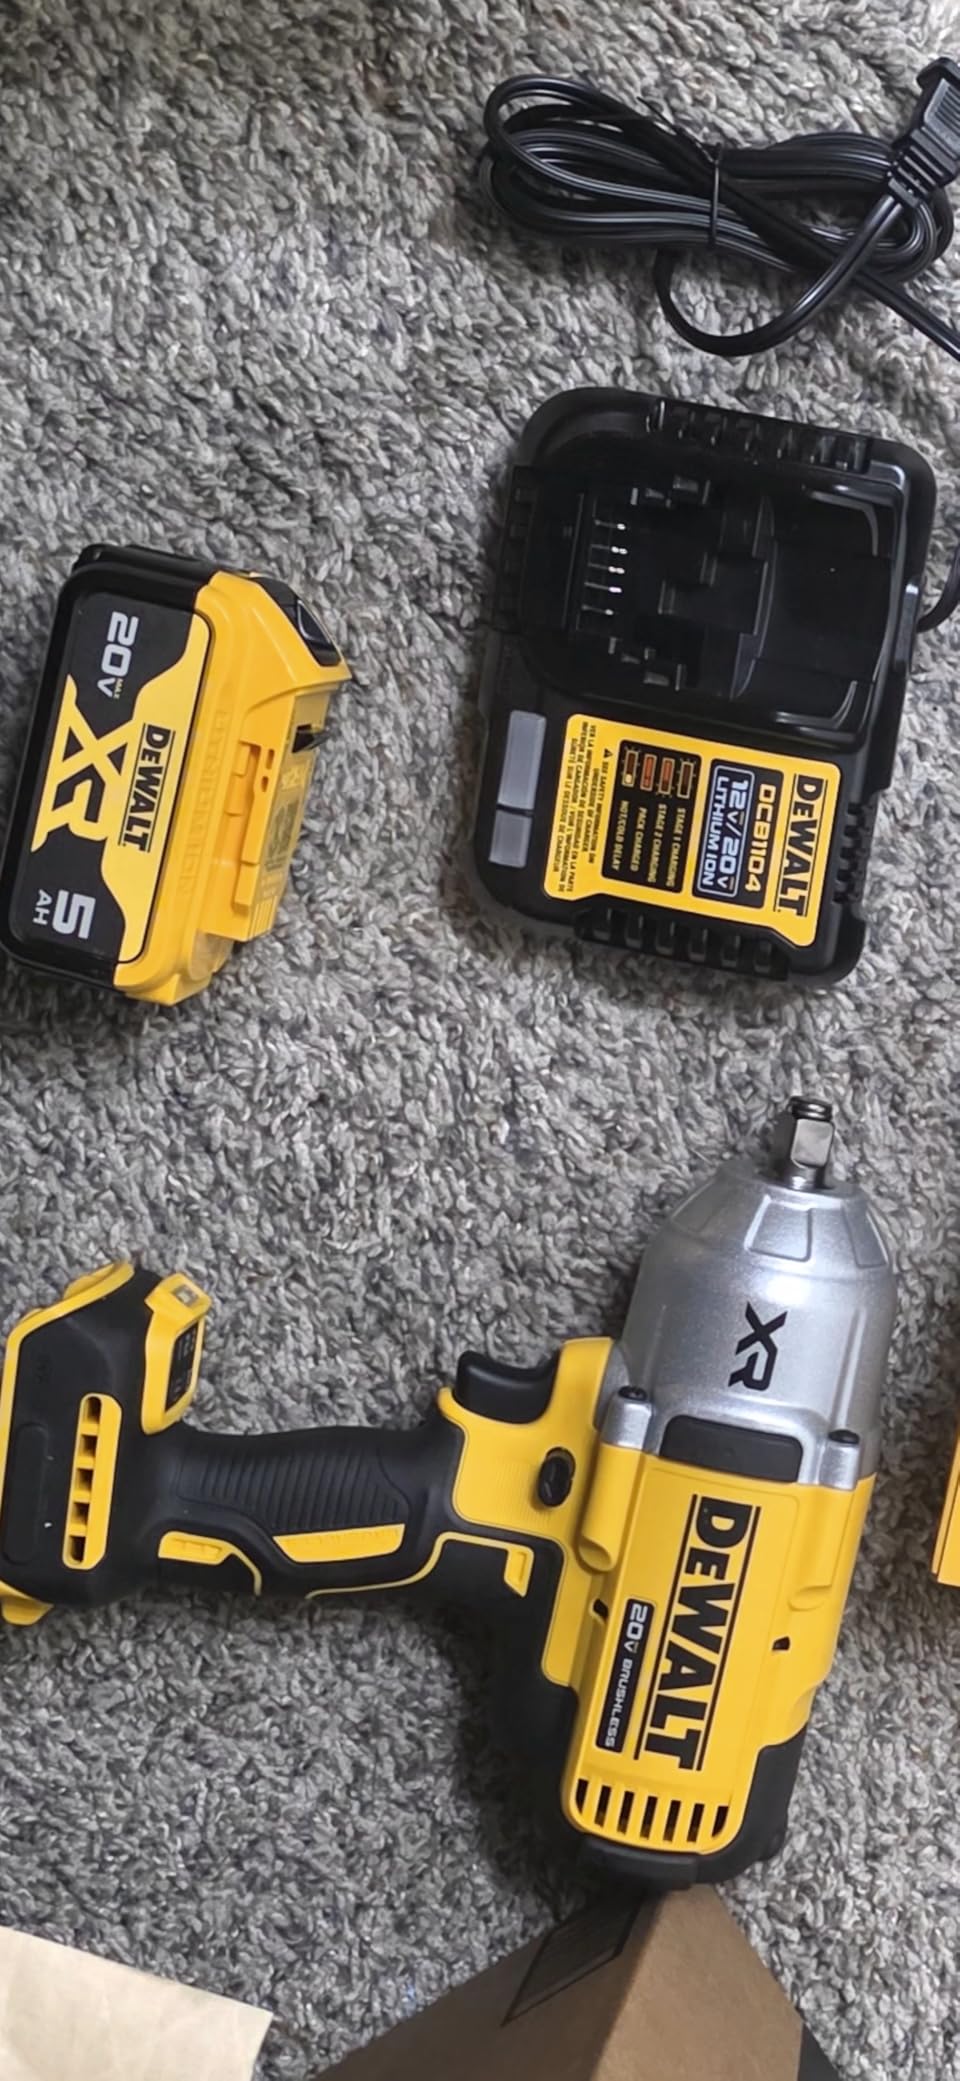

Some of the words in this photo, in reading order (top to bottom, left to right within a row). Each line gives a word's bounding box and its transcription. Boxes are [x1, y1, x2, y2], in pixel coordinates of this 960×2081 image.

[31, 677, 136, 856] XR
[597, 775, 607, 801] SAFETY
[589, 803, 603, 851] INFORMATION
[616, 799, 629, 842] HOT/COLD
[637, 806, 647, 829] PACK
[656, 803, 667, 830] STAGE
[675, 807, 686, 835] STAGE
[706, 775, 729, 848] LITHIUM
[582, 819, 592, 852] CHARGER
[631, 830, 643, 871] CHARGED
[744, 783, 776, 893] DCB1104
[612, 843, 622, 871] DELAY
[648, 838, 661, 882] CHARGING
[667, 842, 680, 887] CHARGING
[701, 852, 717, 885] ION
[566, 871, 575, 892] PARTE
[30, 888, 54, 925] AH
[48, 888, 97, 939] 5
[727, 1300, 787, 1391] XR
[603, 1657, 633, 1748] BRUSHLESS
